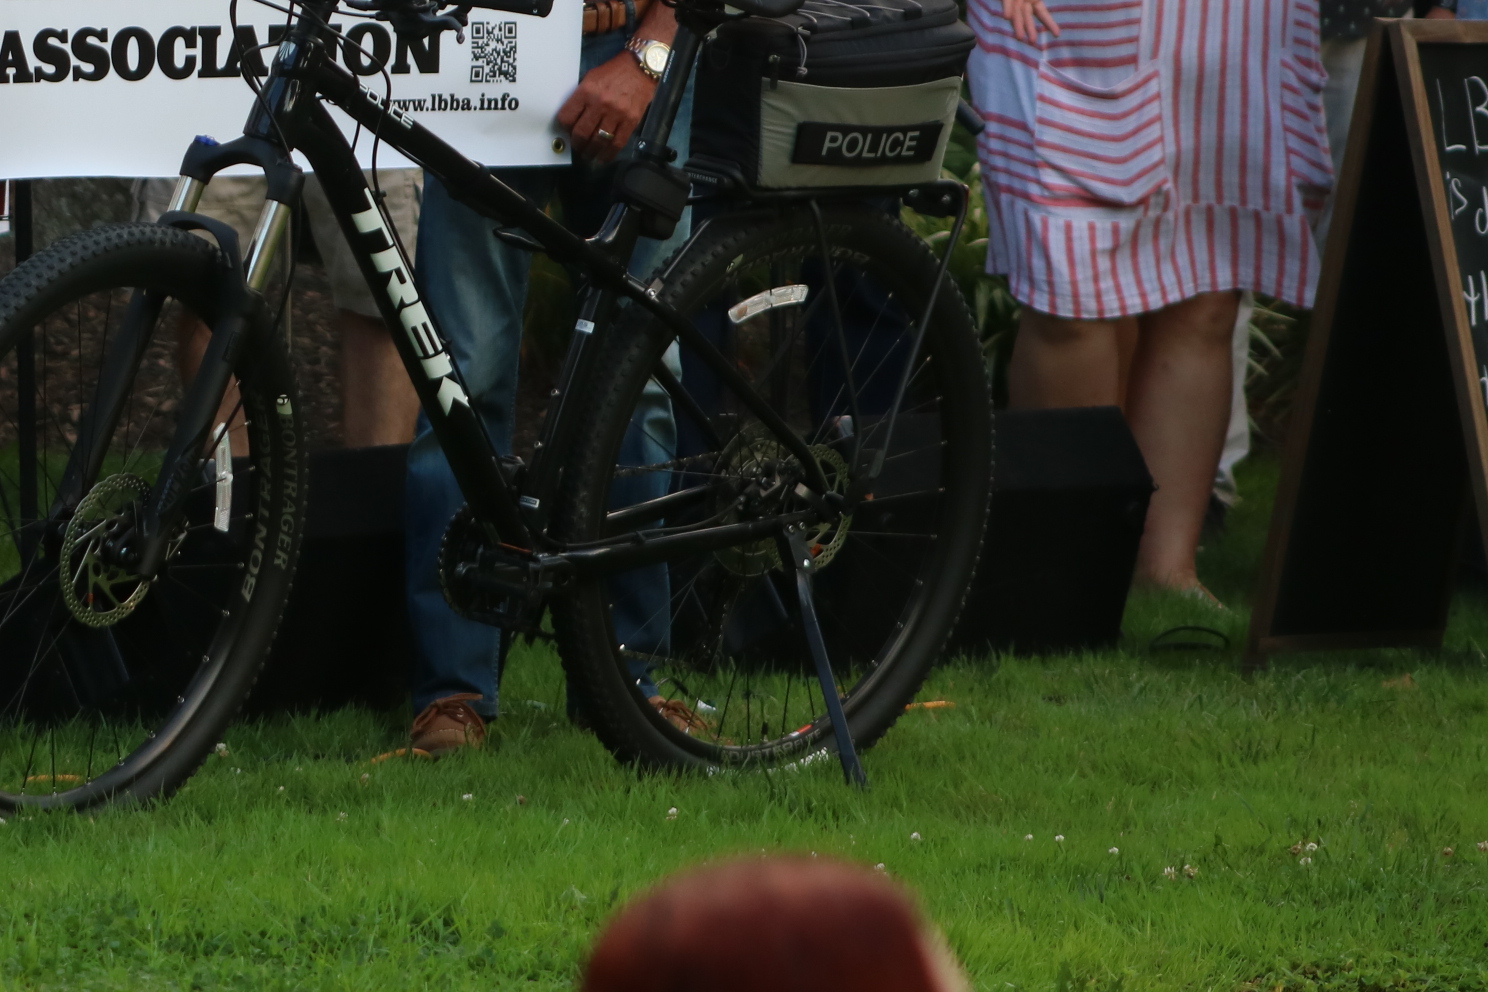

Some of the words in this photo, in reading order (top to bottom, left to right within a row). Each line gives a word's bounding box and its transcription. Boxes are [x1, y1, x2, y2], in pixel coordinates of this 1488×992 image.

[821, 130, 920, 158] POLICE
[351, 186, 470, 418] TREK
[273, 413, 299, 572] BONTRAGER
